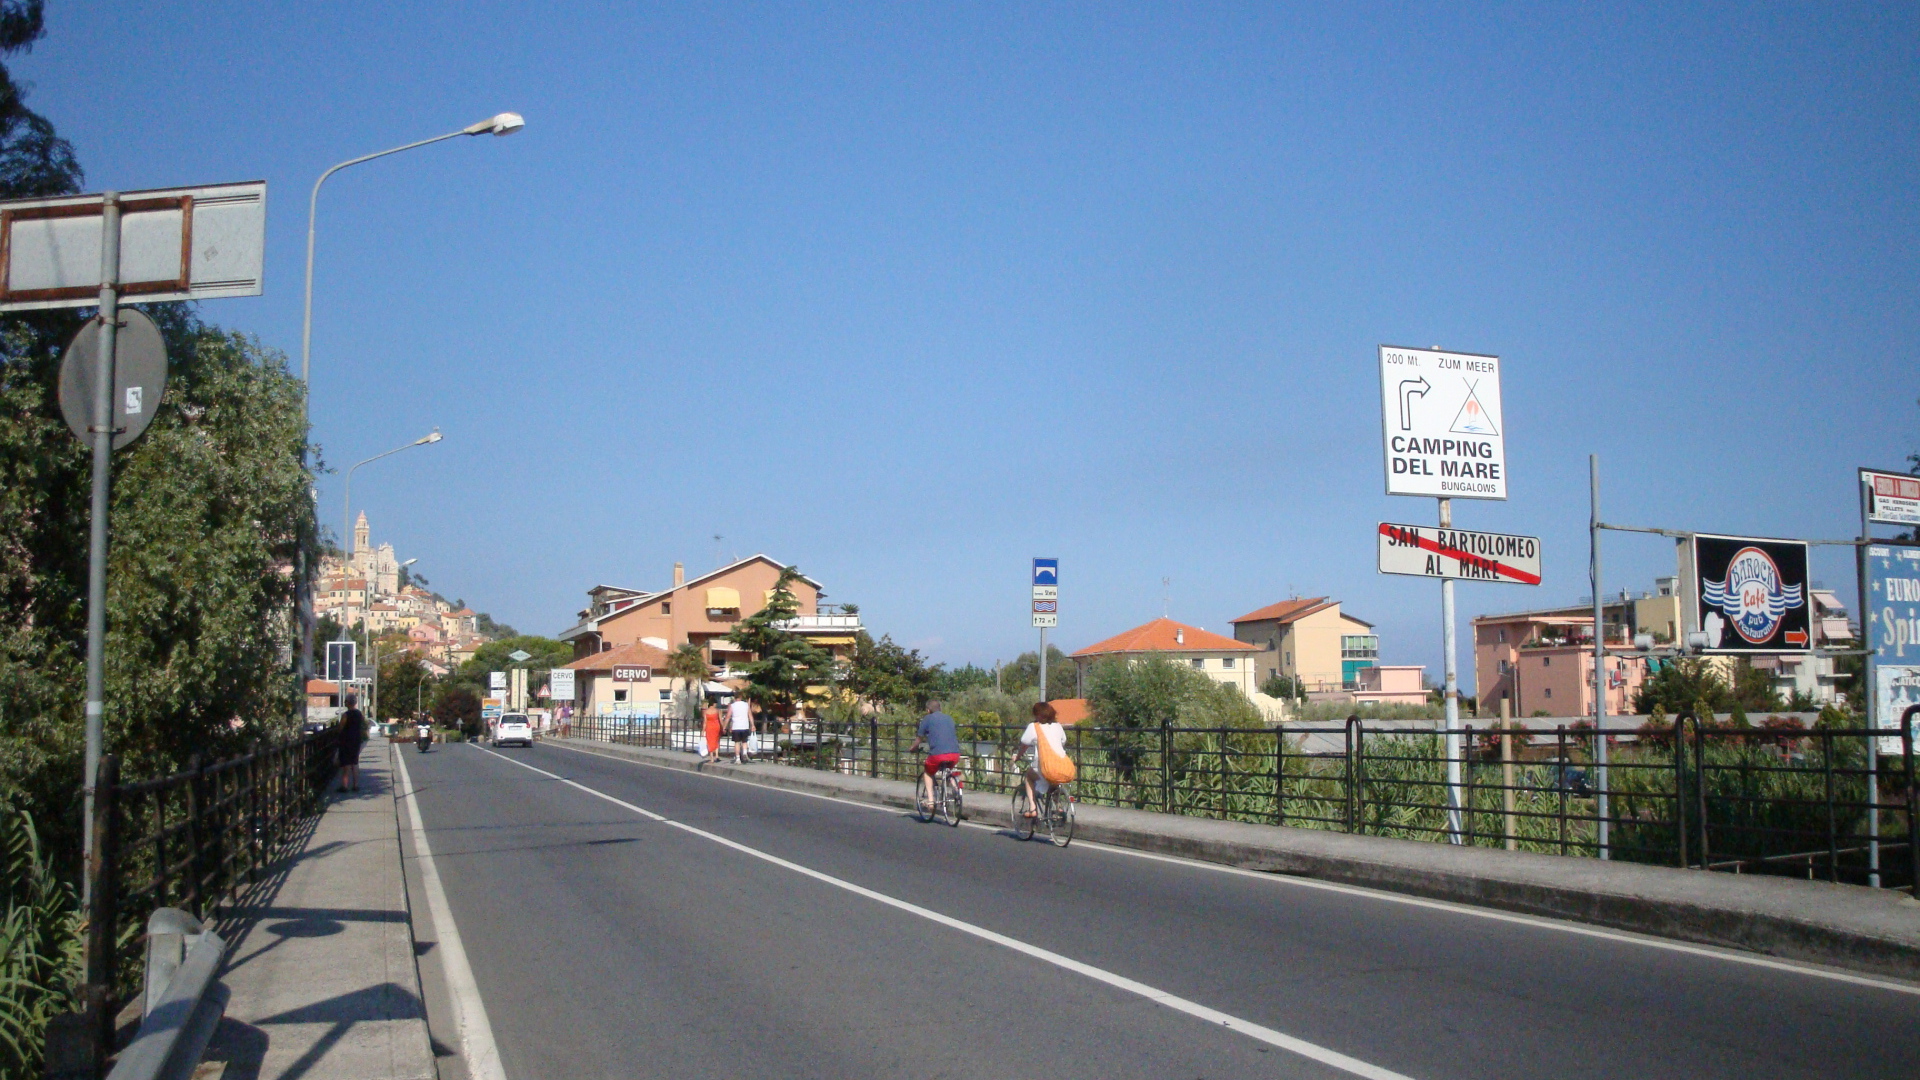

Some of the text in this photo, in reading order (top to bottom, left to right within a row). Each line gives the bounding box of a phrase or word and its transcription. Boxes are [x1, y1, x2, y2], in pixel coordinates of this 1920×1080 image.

[1387, 353, 1403, 365] 200
[1438, 358, 1461, 370] ZUM
[1466, 361, 1495, 373] MEER
[1391, 436, 1493, 459] CAMPING
[1392, 457, 1500, 480] DEL MARE
[1441, 481, 1496, 493] BUNGALOWS
[1388, 526, 1535, 559] SAN BARTOLOMEO
[1425, 555, 1500, 579] AL MARE
[1731, 557, 1774, 589] BAROCK
[1743, 588, 1765, 609] Café
[1885, 577, 1920, 602] EURO
[1737, 619, 1774, 639] restaurant
[1747, 615, 1764, 626] pub
[616, 668, 648, 679] CERVO
